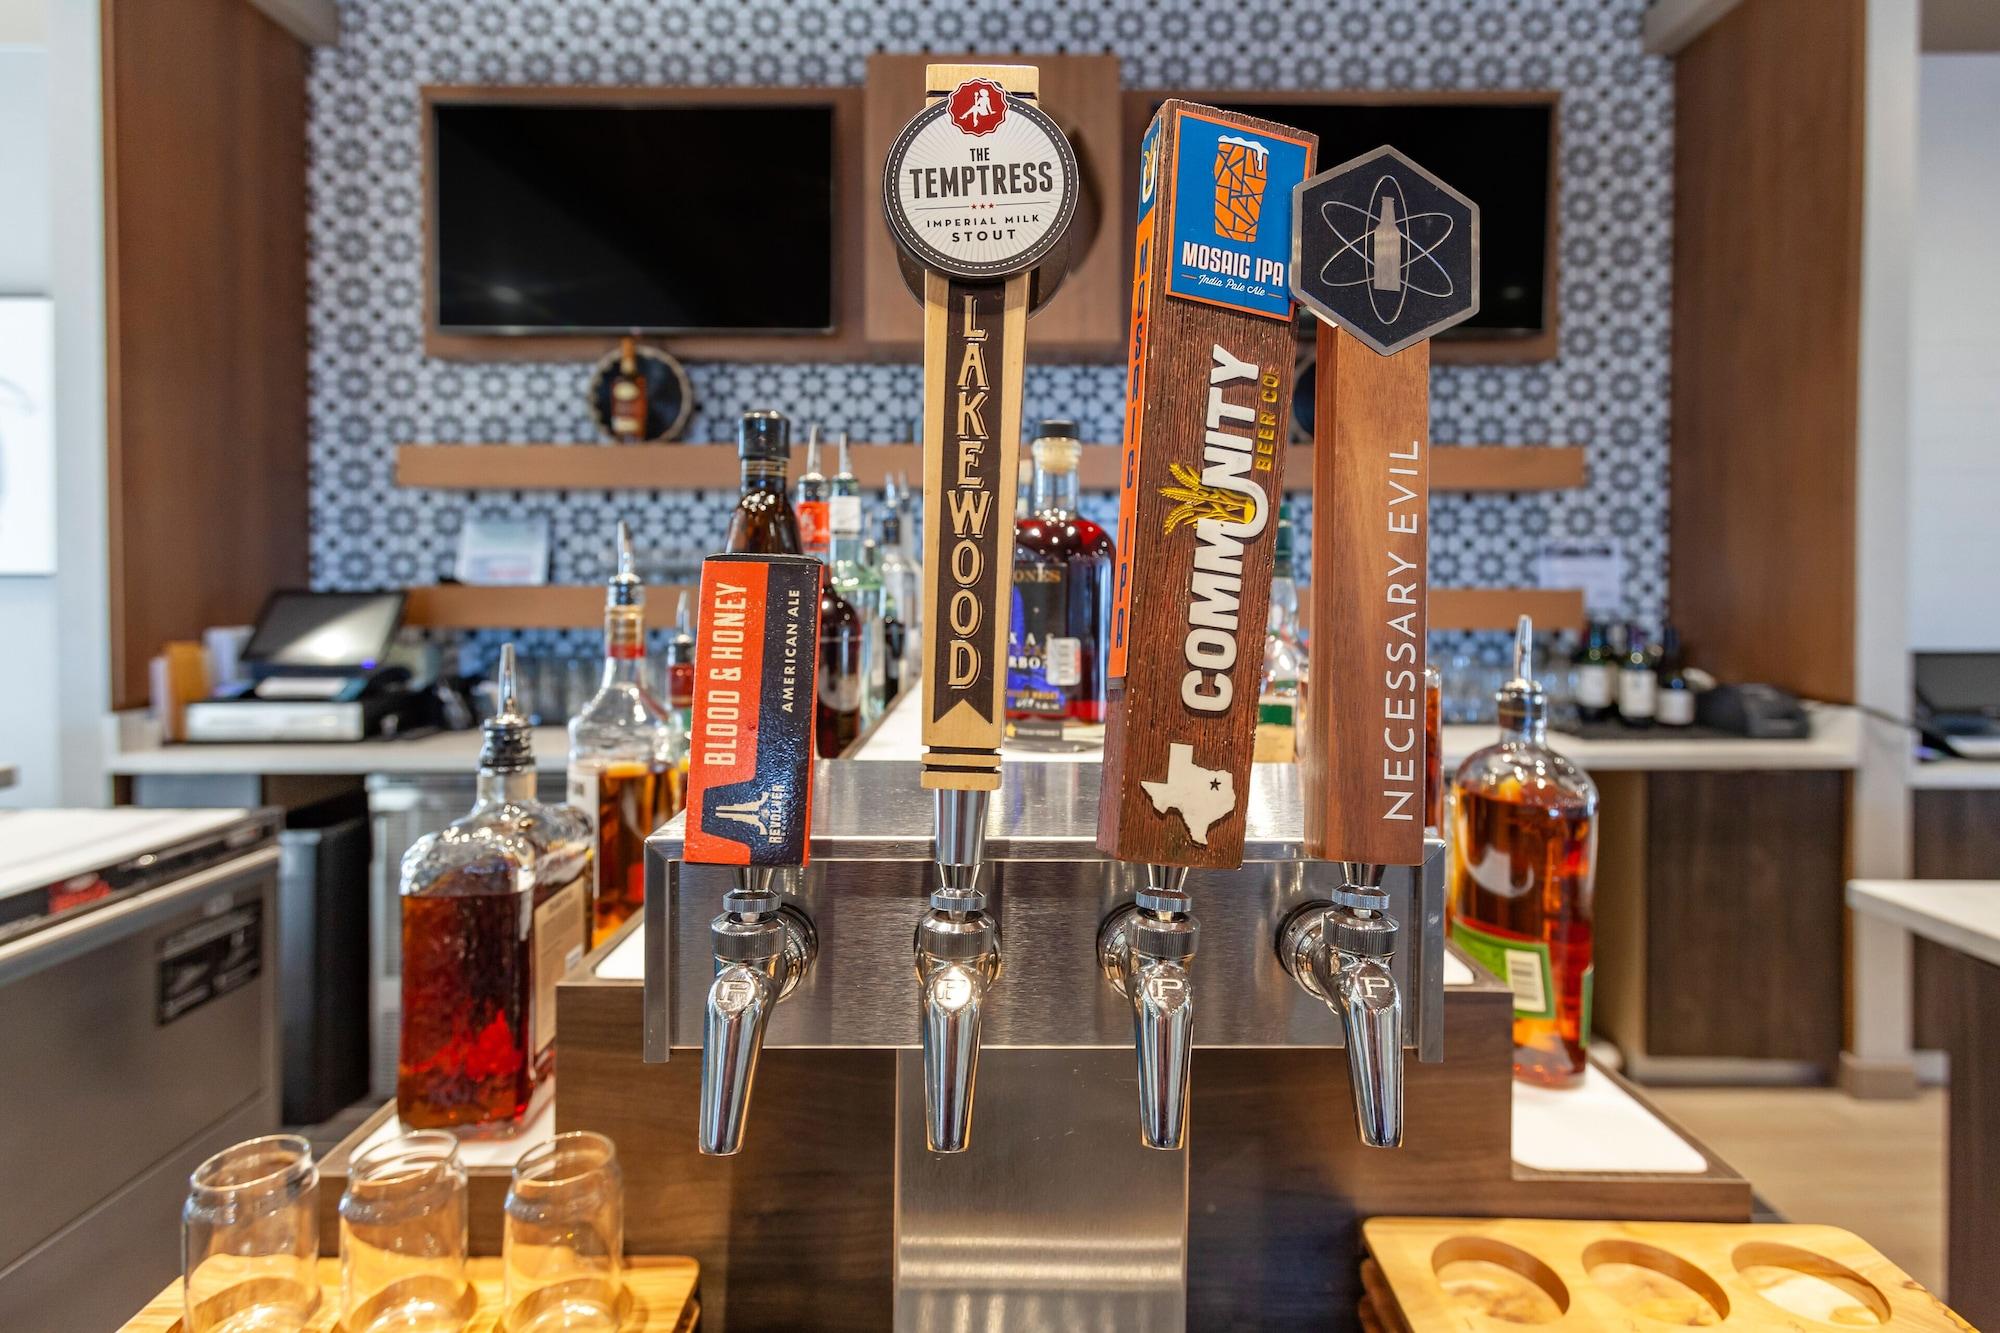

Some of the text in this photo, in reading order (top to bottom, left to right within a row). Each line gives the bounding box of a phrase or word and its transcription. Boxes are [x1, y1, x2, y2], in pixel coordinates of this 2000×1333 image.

[909, 161, 1053, 199] TEMPTRESS
[969, 148, 990, 162] THE
[926, 214, 1040, 228] IMPERIAL MILK
[951, 229, 1016, 243] STOUT
[1181, 240, 1285, 288] MOSAIC IPA
[1198, 273, 1266, 297] India Pale Ale
[1116, 237, 1149, 649] MOSAIC IPA
[1255, 411, 1277, 472] BEER
[946, 294, 994, 690] LAKEWOOD
[1181, 343, 1270, 712] COMMUNITY
[781, 588, 801, 714] AMERICAN ALE
[1382, 440, 1420, 821] NECESSARY EVIL
[703, 581, 748, 766] BLOOD & HONEY
[1359, 976, 1390, 999] P
